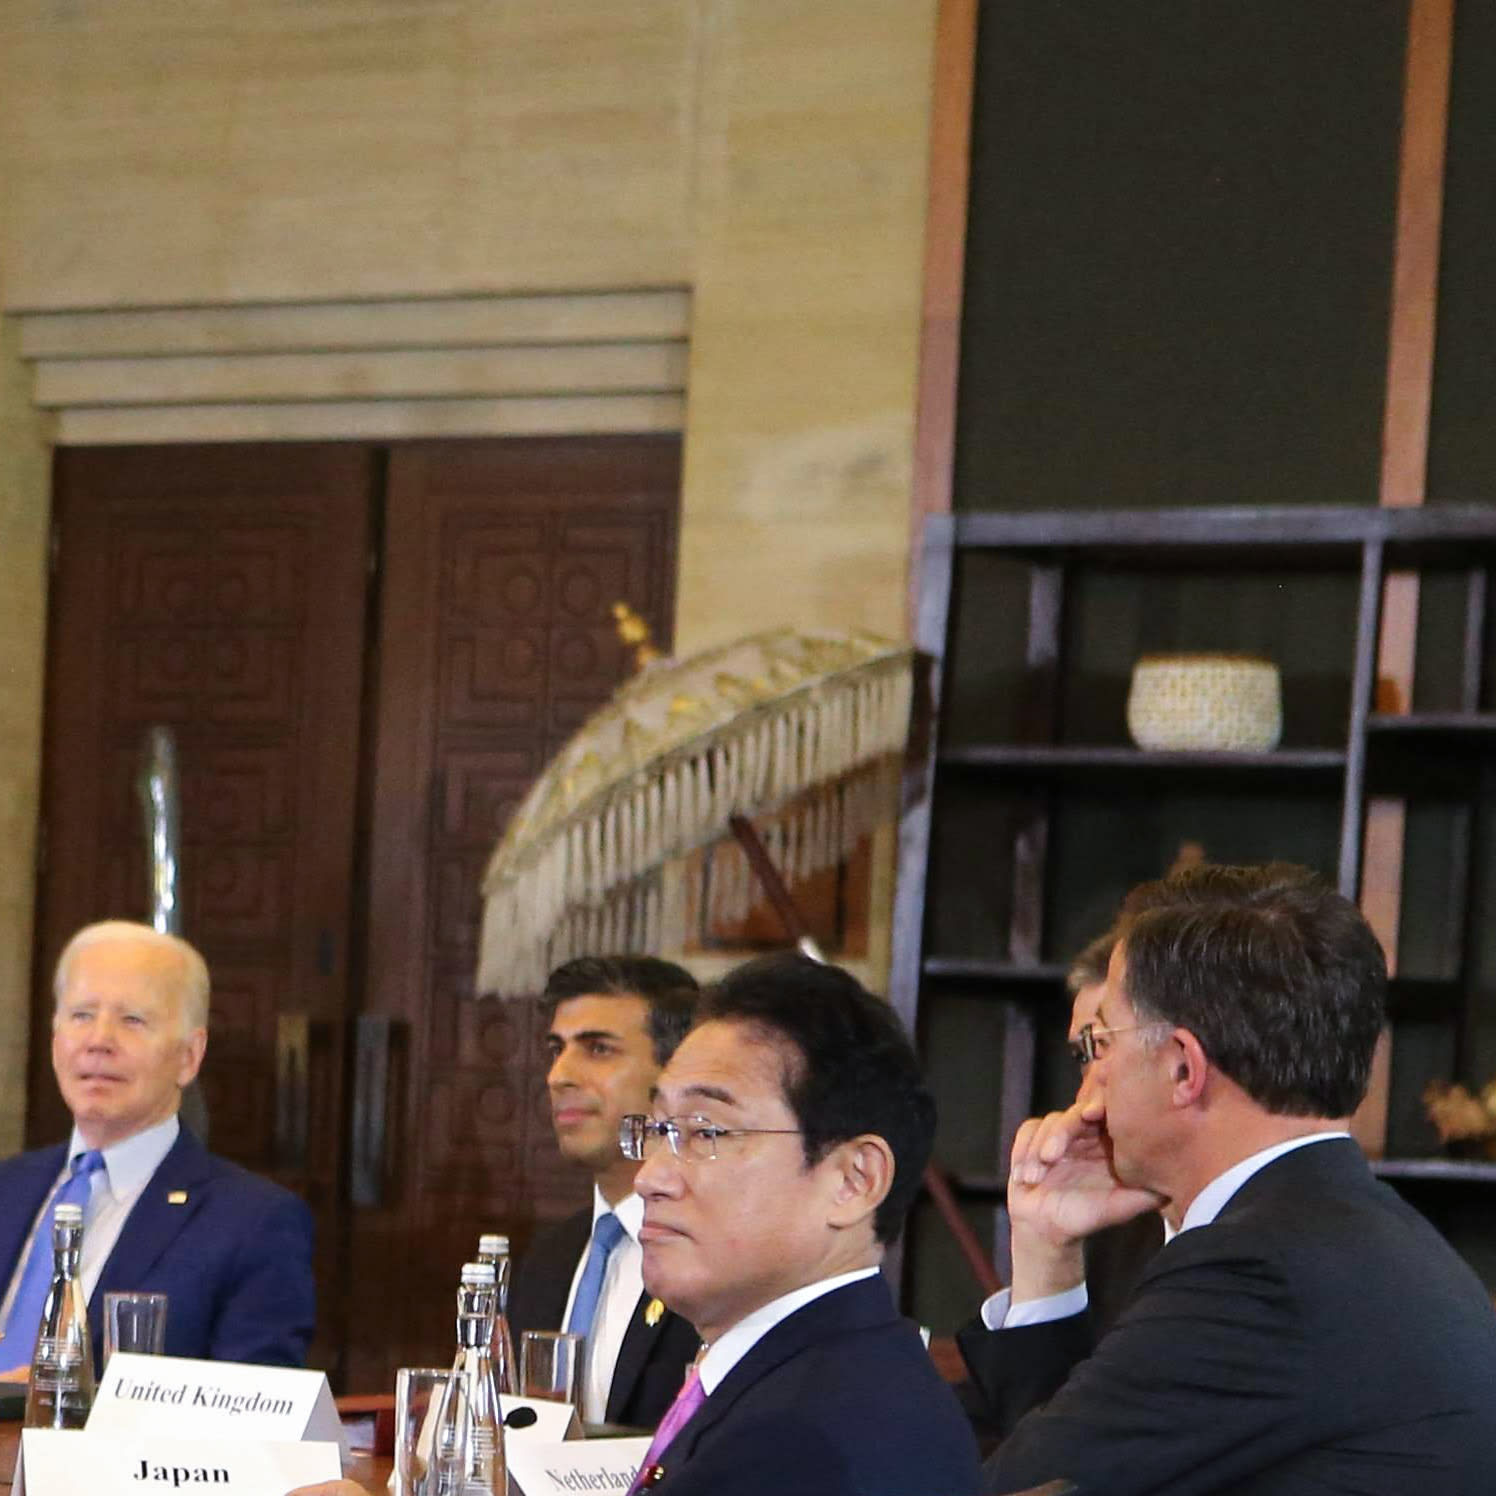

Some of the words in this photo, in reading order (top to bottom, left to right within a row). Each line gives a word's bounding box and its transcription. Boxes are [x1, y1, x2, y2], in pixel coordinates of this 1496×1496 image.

[113, 1378, 188, 1405] United
[192, 1385, 294, 1416] Kingdom
[133, 1460, 230, 1488] Japan
